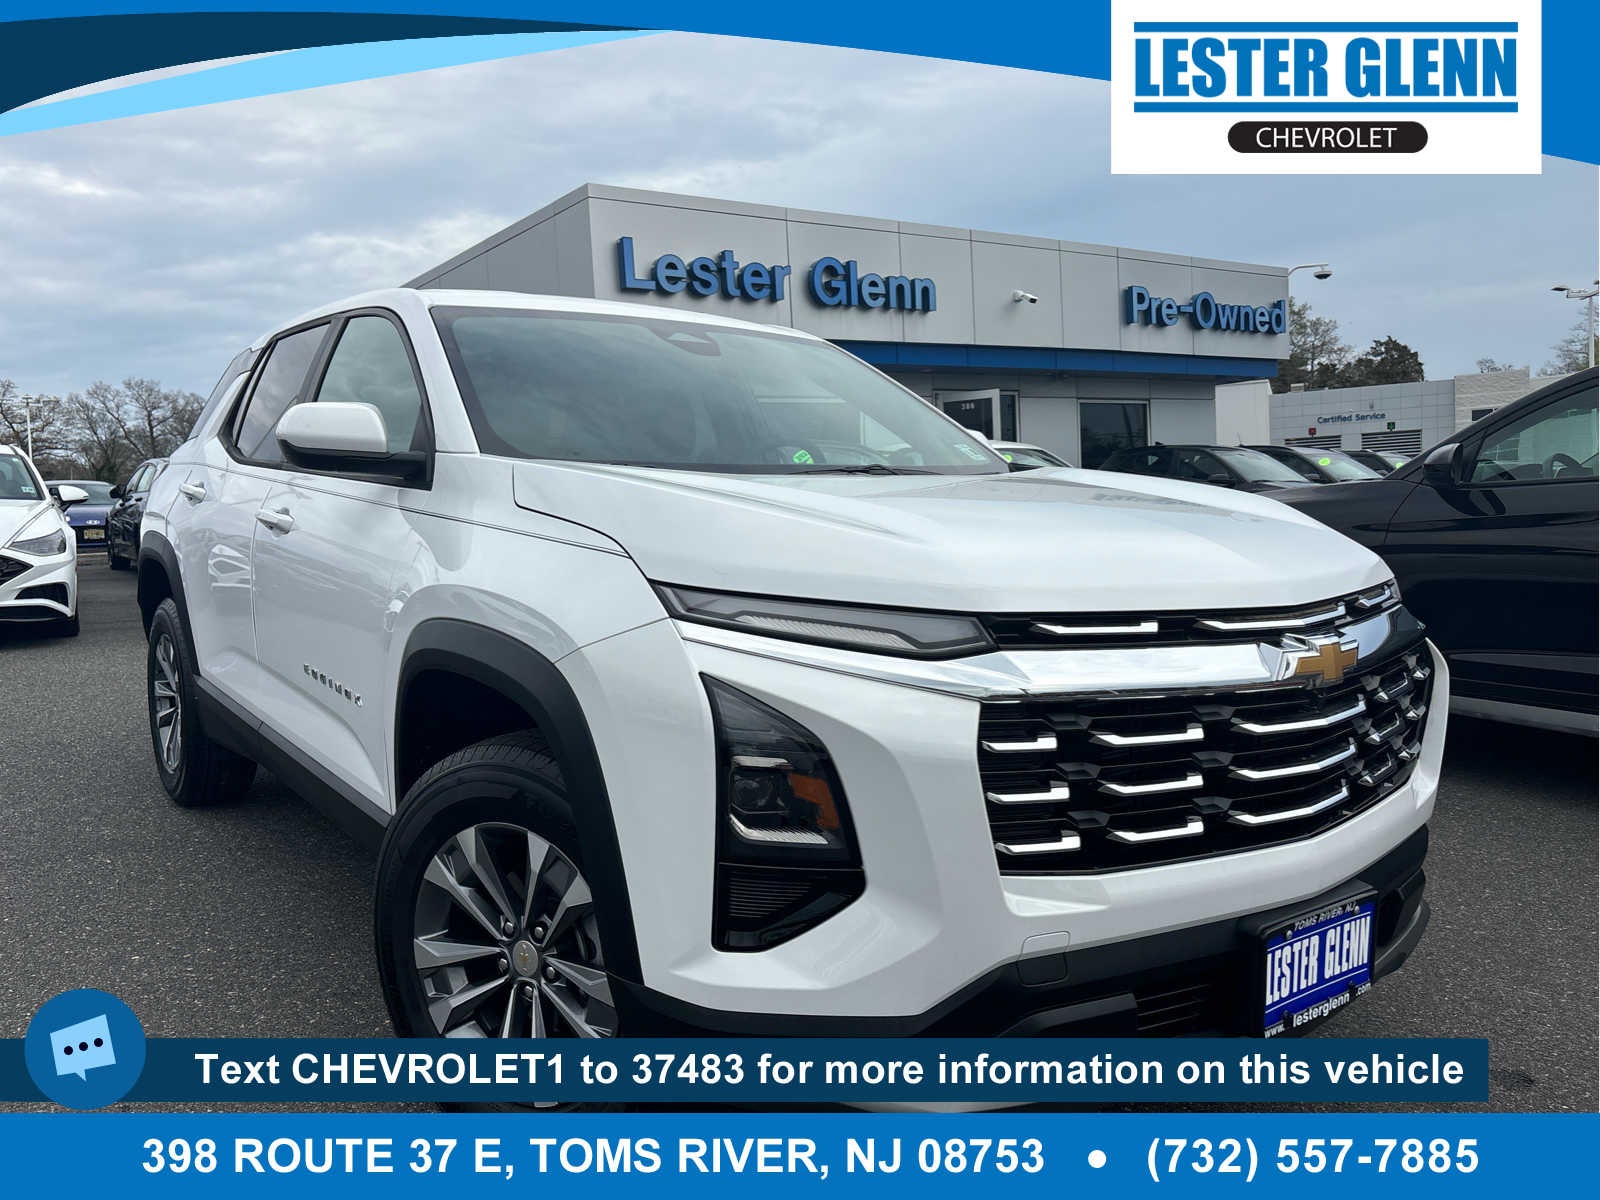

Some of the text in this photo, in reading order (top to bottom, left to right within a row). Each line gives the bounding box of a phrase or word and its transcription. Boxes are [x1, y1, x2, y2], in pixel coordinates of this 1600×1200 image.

[617, 236, 936, 312] Lester Glenn
[1126, 285, 1287, 335] Pre-Owned
[1317, 412, 1386, 424] Certified Service
[1294, 915, 1318, 931] TOMS
[1265, 915, 1371, 1006] LESTER GLENN
